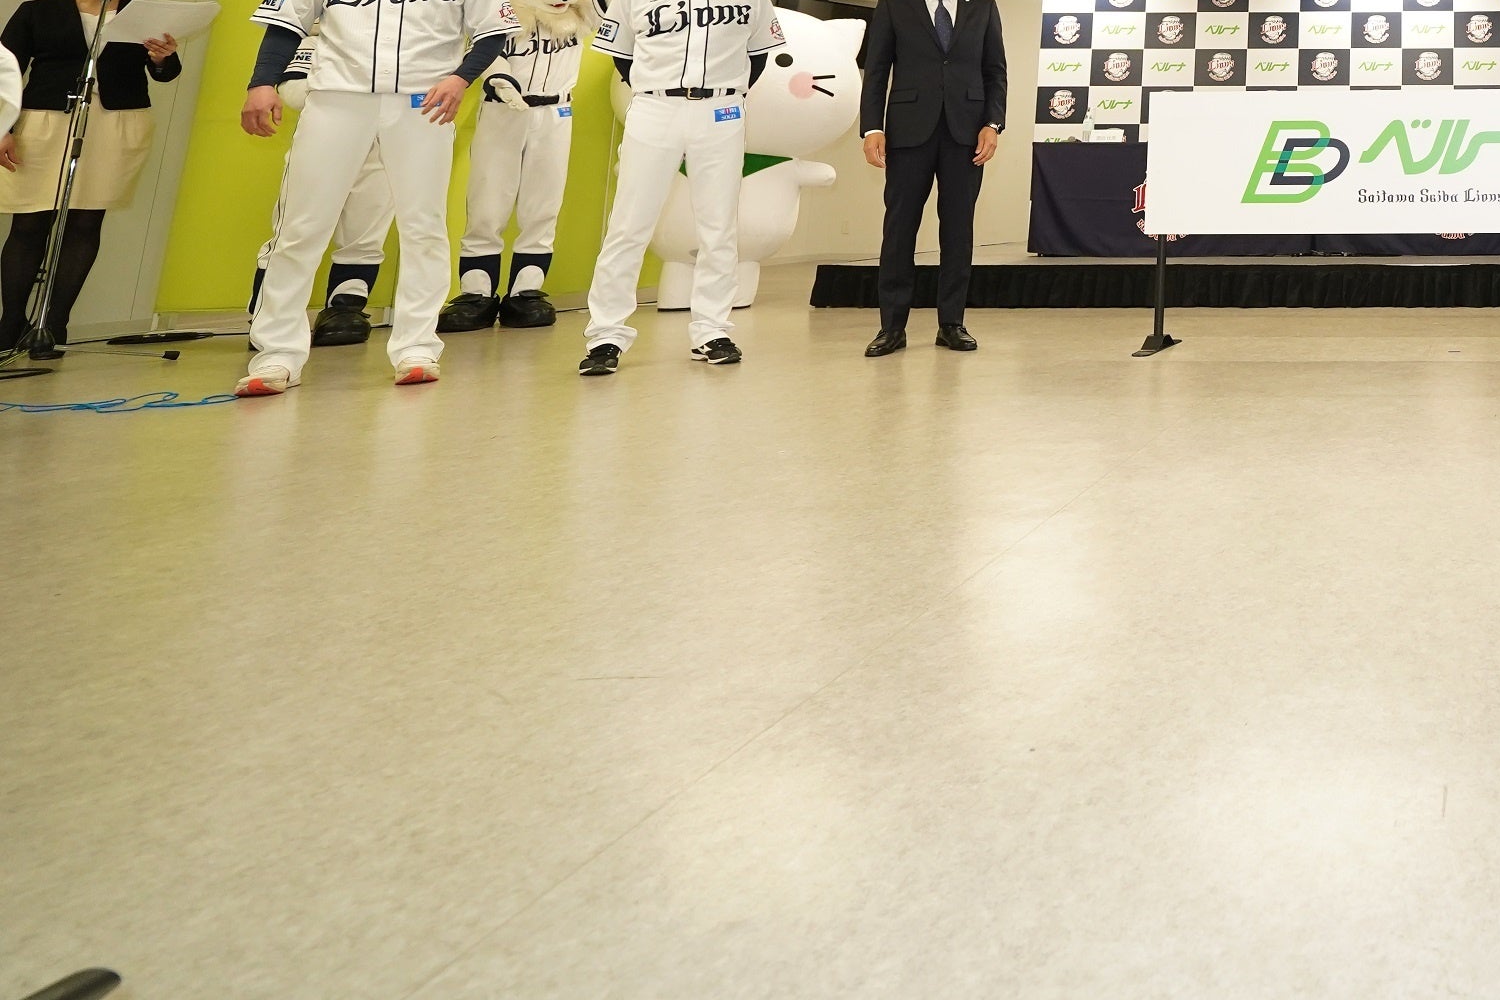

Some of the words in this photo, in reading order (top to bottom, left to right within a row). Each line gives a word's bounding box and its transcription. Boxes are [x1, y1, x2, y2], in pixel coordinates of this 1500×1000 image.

[644, 0, 751, 38] Lions
[599, 27, 611, 37] NE
[1205, 25, 1240, 35] ベルーナ
[1047, 62, 1082, 72] ベルーナ
[1151, 62, 1186, 72] ベルーナ
[1255, 62, 1290, 71] ベルーナ
[1359, 61, 1393, 71] ベルーナ
[1462, 61, 1497, 71] ベルーナ
[1097, 100, 1132, 110] ベルーナ
[1358, 188, 1415, 203] Saitama
